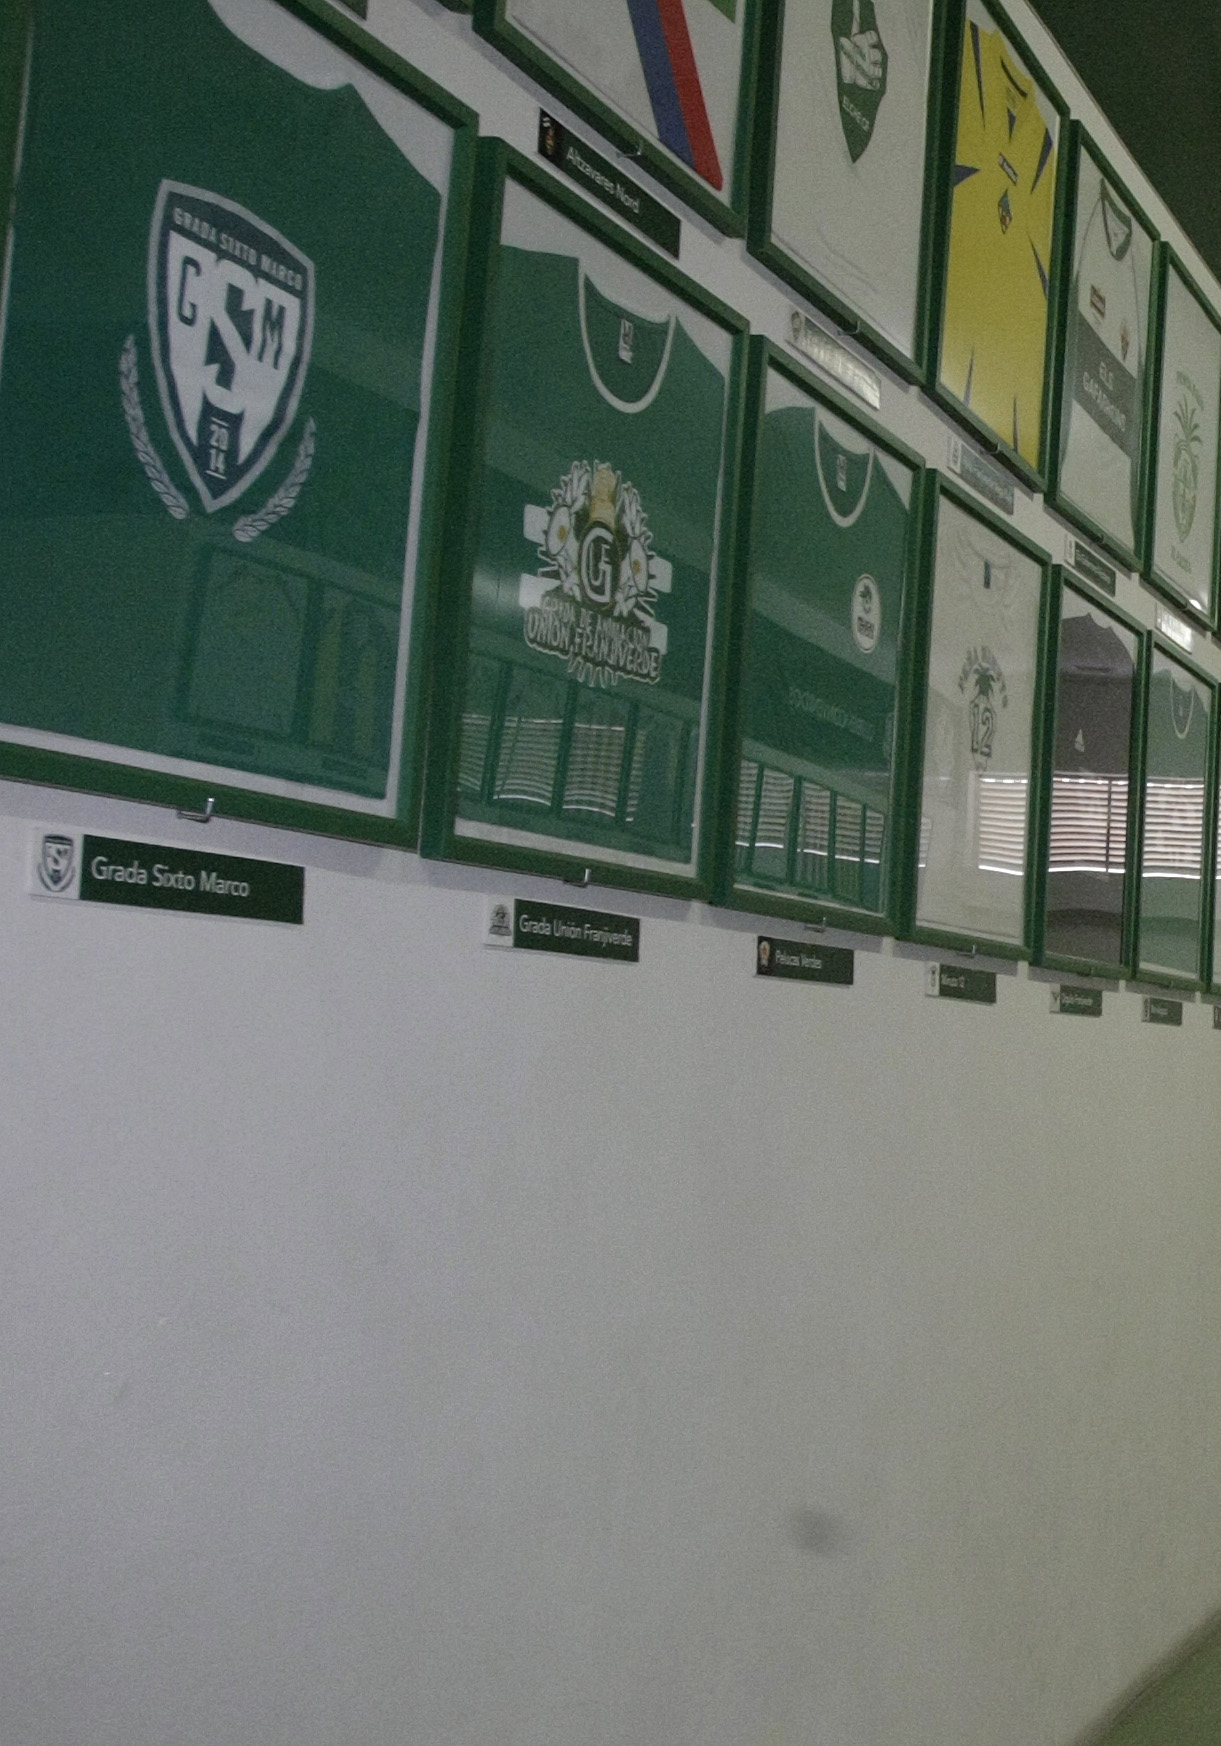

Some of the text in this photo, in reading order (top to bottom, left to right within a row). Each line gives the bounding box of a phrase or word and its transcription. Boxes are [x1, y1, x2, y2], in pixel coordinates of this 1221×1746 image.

[615, 183, 639, 214] Nord
[173, 207, 303, 291] GRADA SIXTO MARCO
[208, 424, 229, 451] 20
[209, 449, 226, 475] 14
[970, 701, 994, 758] 12
[91, 856, 249, 897] Grada Sixto Marco
[519, 913, 633, 948] Grada Unión Franjiverde
